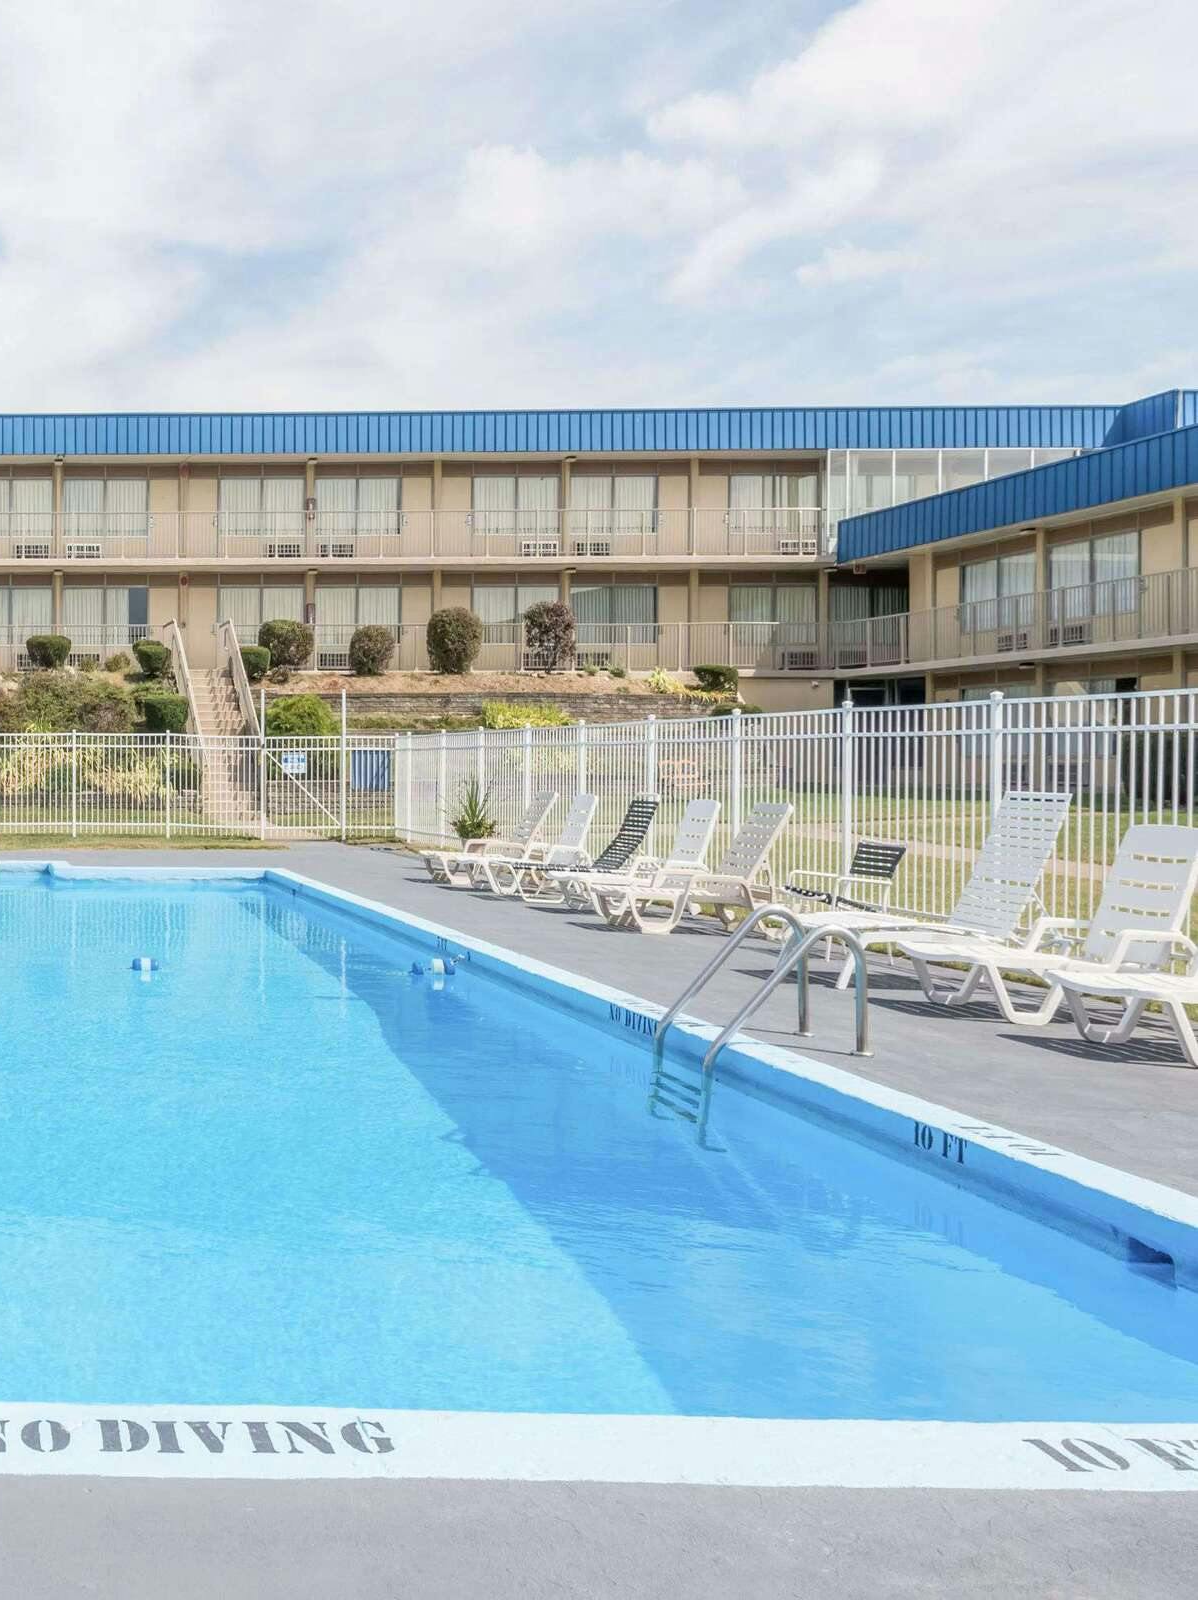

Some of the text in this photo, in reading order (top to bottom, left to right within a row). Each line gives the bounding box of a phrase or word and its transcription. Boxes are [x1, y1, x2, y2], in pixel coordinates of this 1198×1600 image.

[609, 1002, 622, 1021] NO
[913, 1120, 968, 1165] 10 FT
[95, 1417, 396, 1455] DIVING
[1020, 1438, 1198, 1473] 10 F
